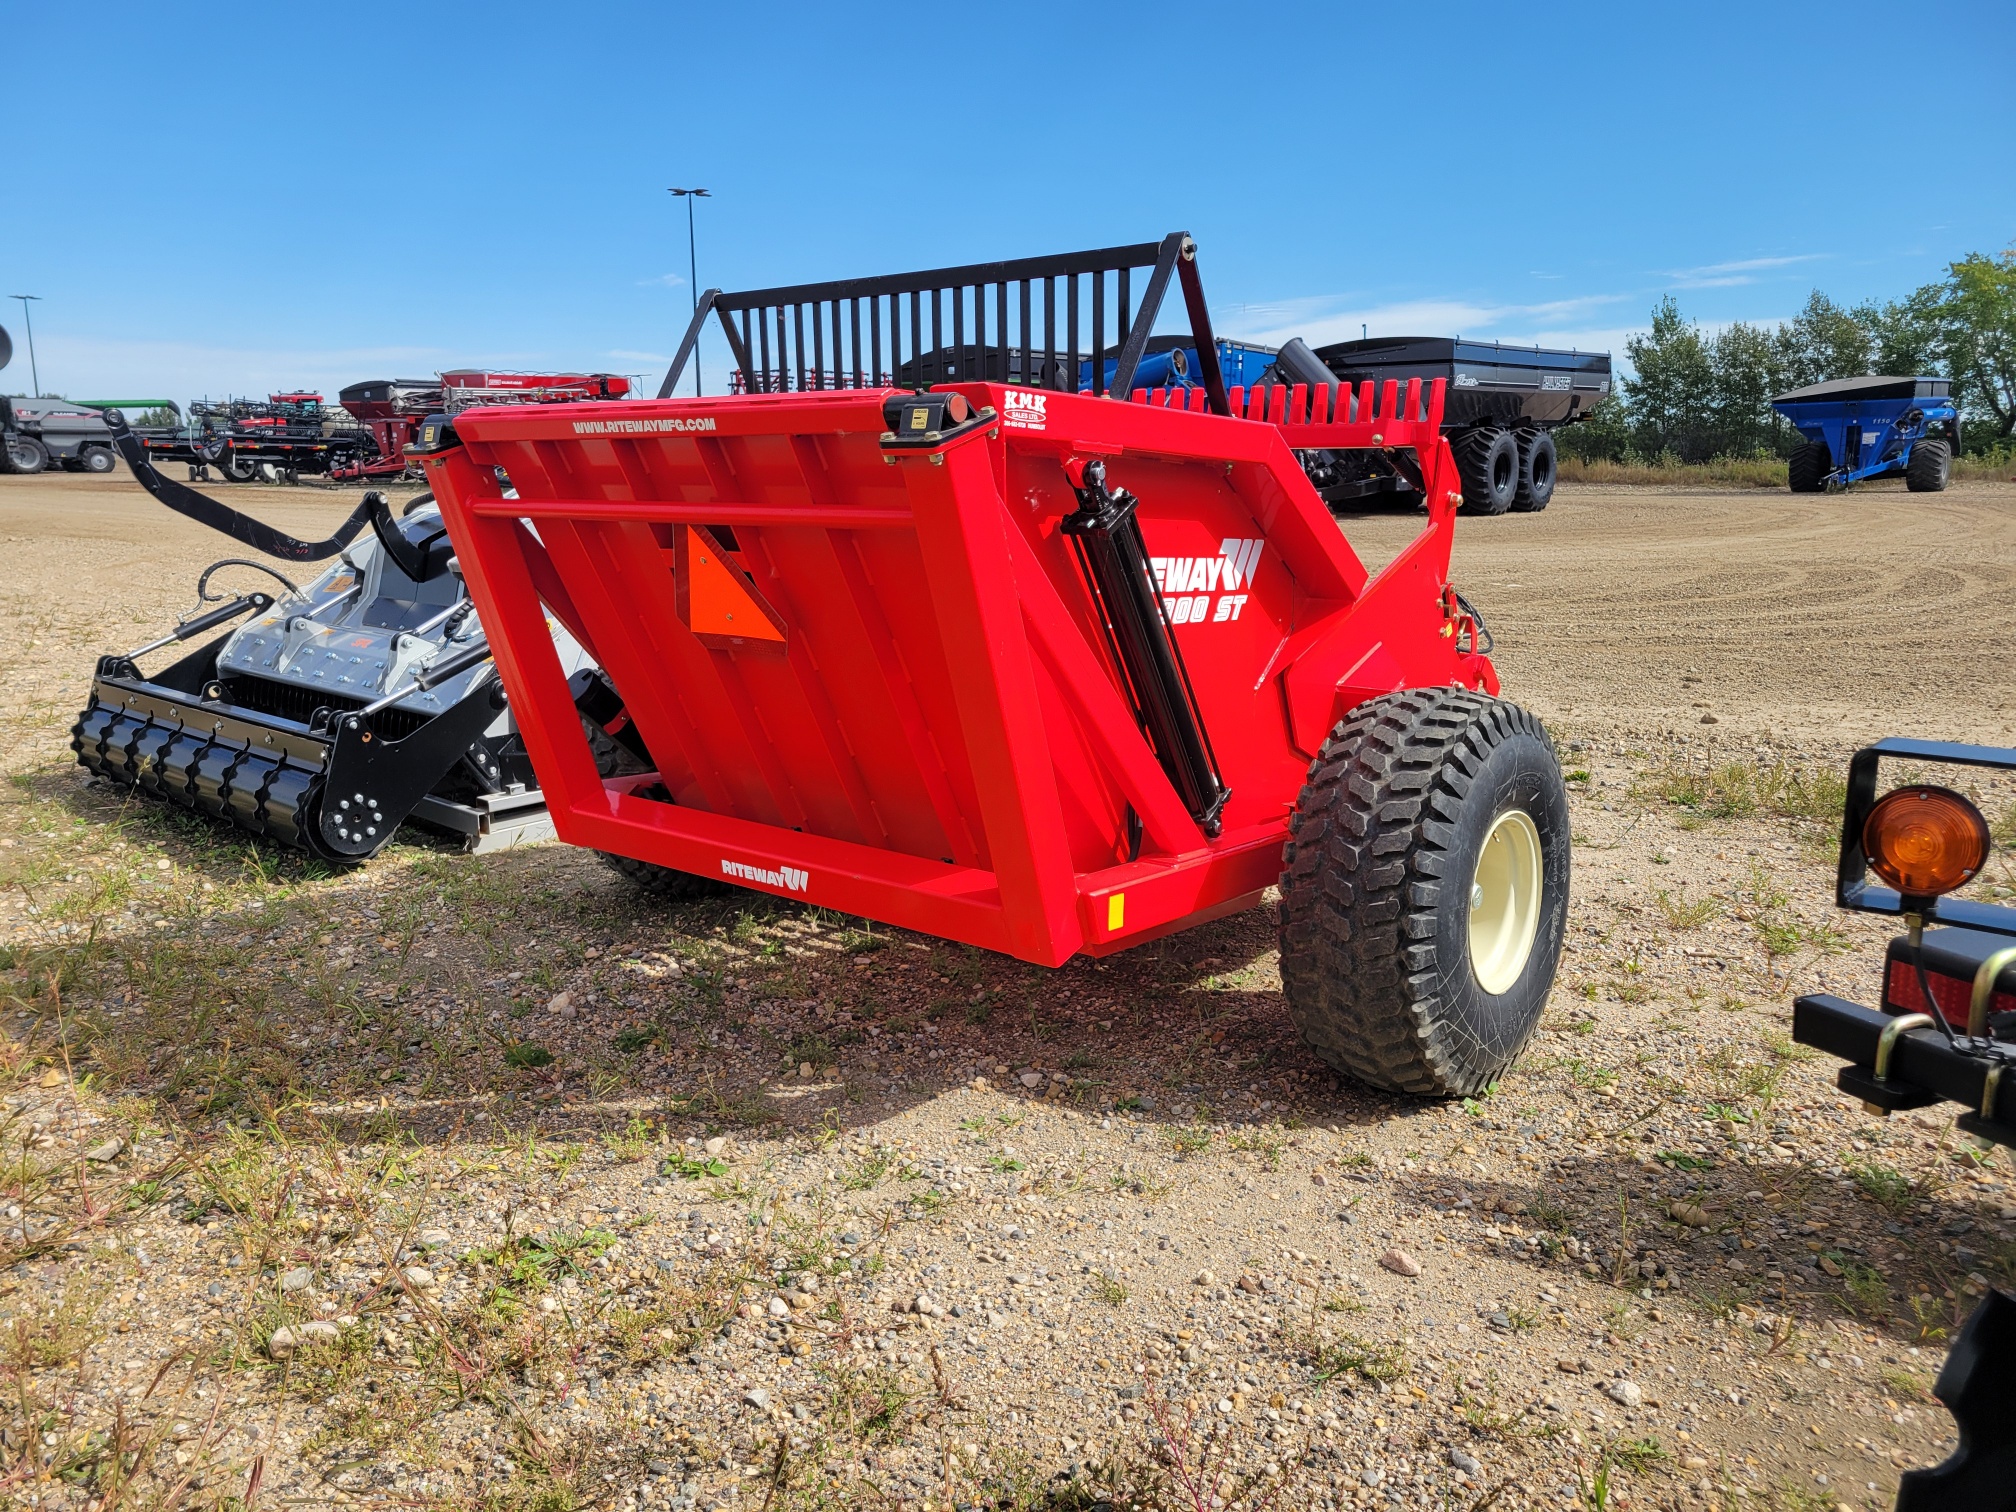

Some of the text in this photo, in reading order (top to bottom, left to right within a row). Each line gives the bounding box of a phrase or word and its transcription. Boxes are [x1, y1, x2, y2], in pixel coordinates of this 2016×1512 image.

[573, 418, 716, 434] WWW.RITEWAYMFG.COM
[1011, 411, 1028, 420] SALES
[1143, 557, 1225, 593] EWAY
[1213, 594, 1248, 622] ST
[721, 859, 786, 888] RITEWAY
